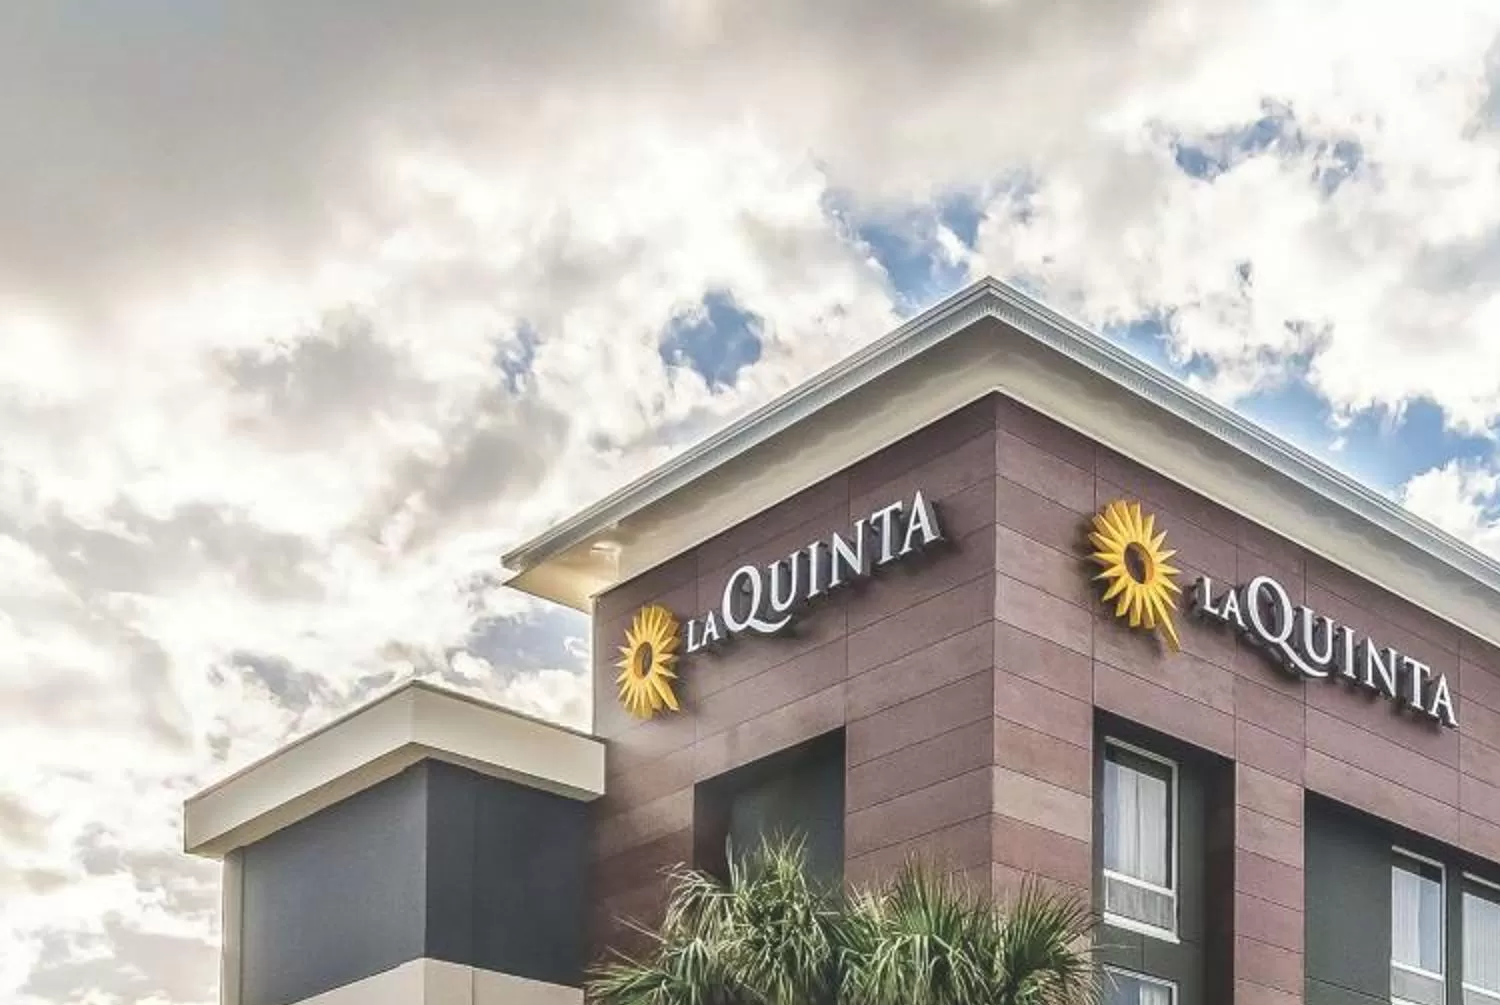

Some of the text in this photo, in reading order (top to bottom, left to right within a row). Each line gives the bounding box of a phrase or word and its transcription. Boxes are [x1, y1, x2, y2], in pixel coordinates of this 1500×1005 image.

[686, 489, 943, 653] LA QUINTA
[1201, 575, 1460, 729] LA QUINTA
